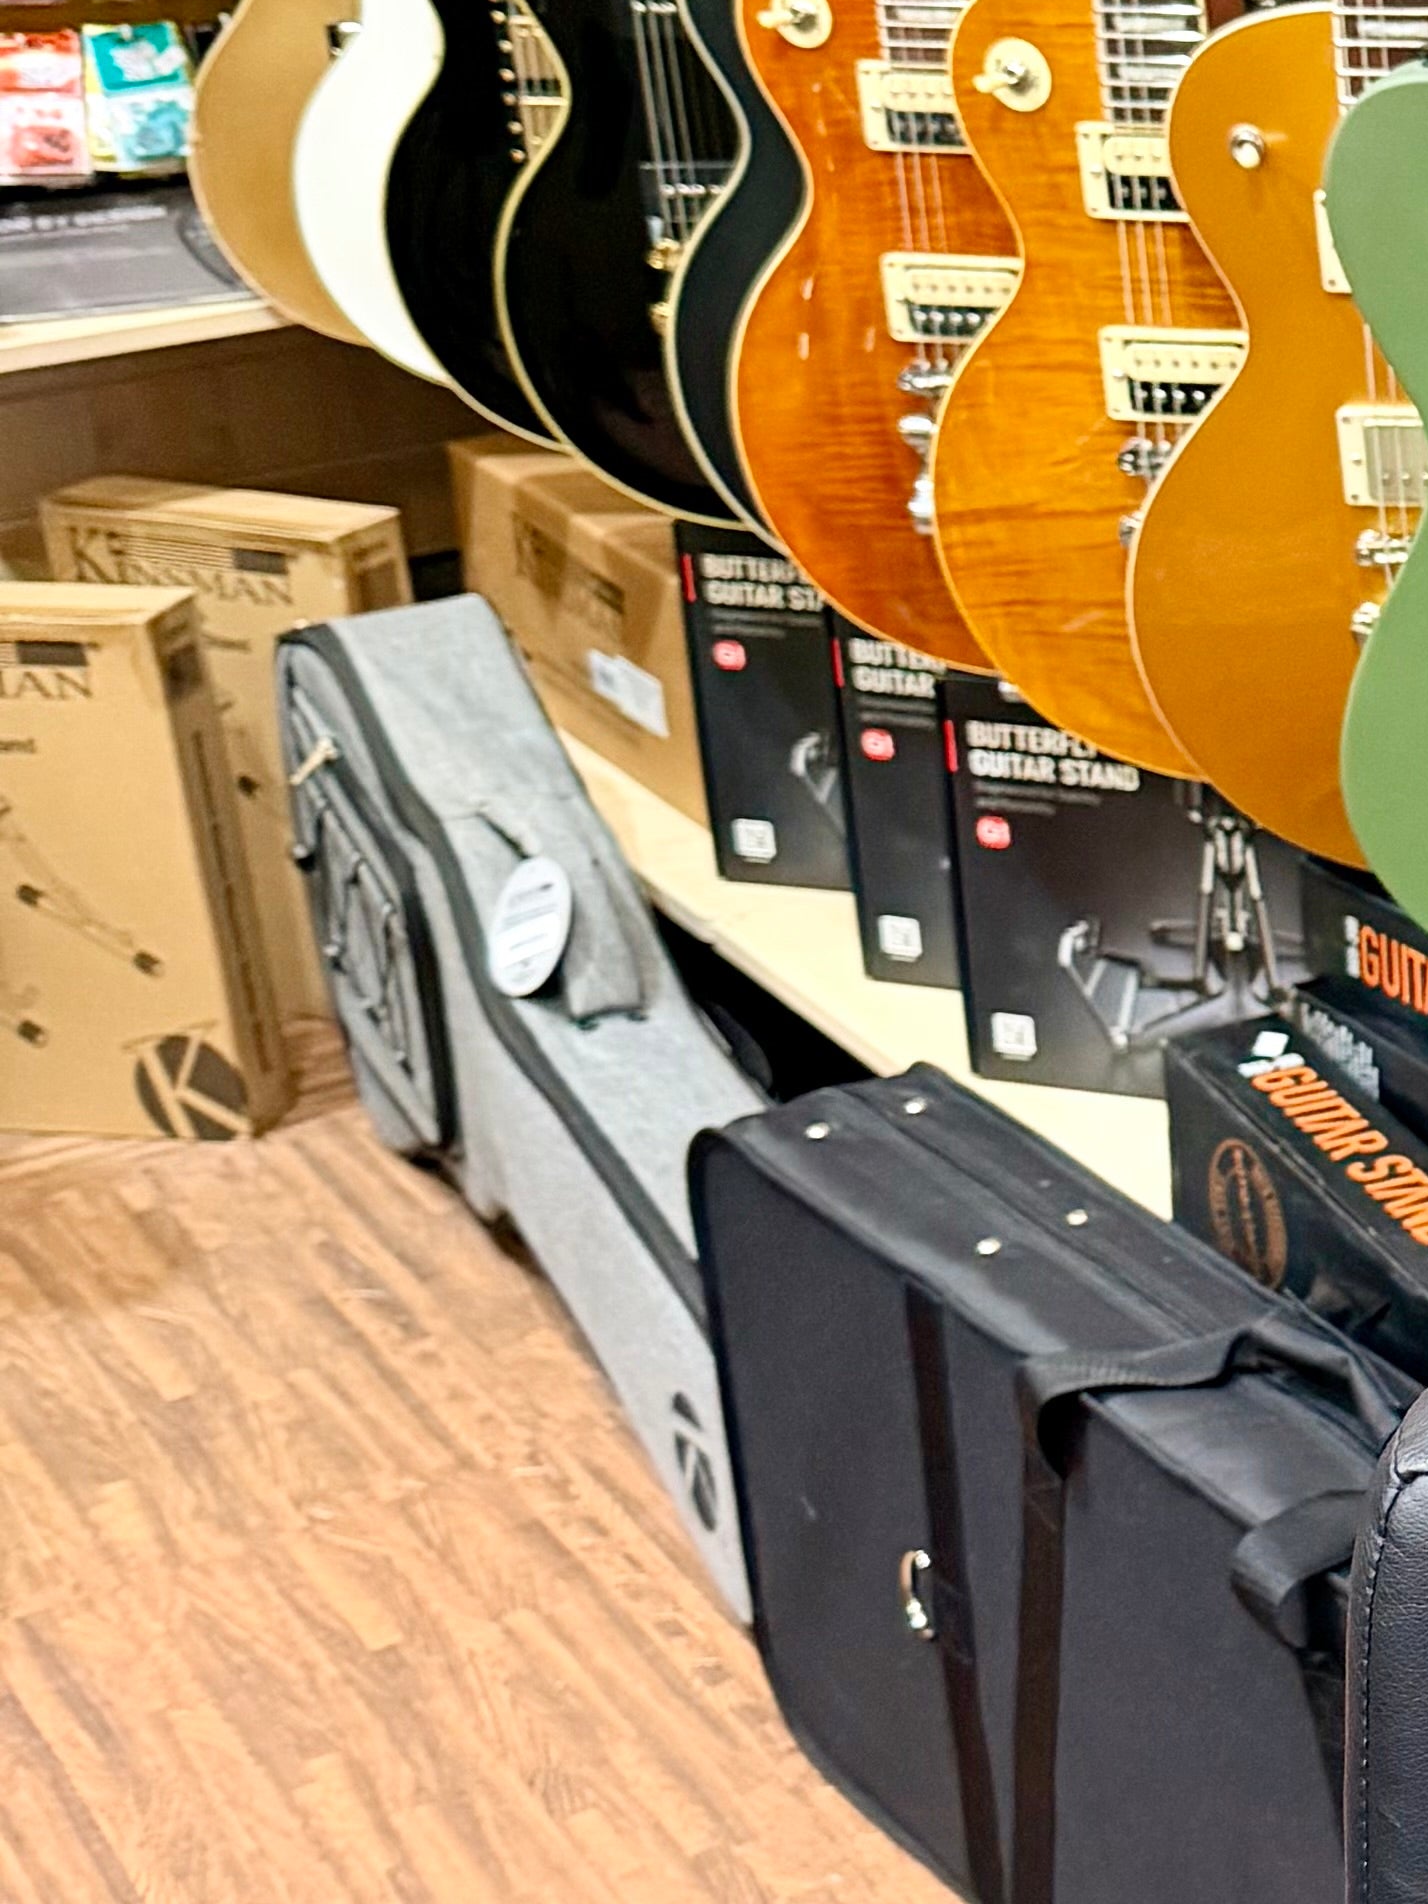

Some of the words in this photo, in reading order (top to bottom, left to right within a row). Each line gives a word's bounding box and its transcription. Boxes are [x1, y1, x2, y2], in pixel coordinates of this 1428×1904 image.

[704, 580, 783, 610] GUITAR
[852, 666, 936, 699] GUITAR
[967, 749, 1056, 783] GUITAR
[1059, 758, 1140, 792] STAND
[1251, 1066, 1389, 1163] GUITAR
